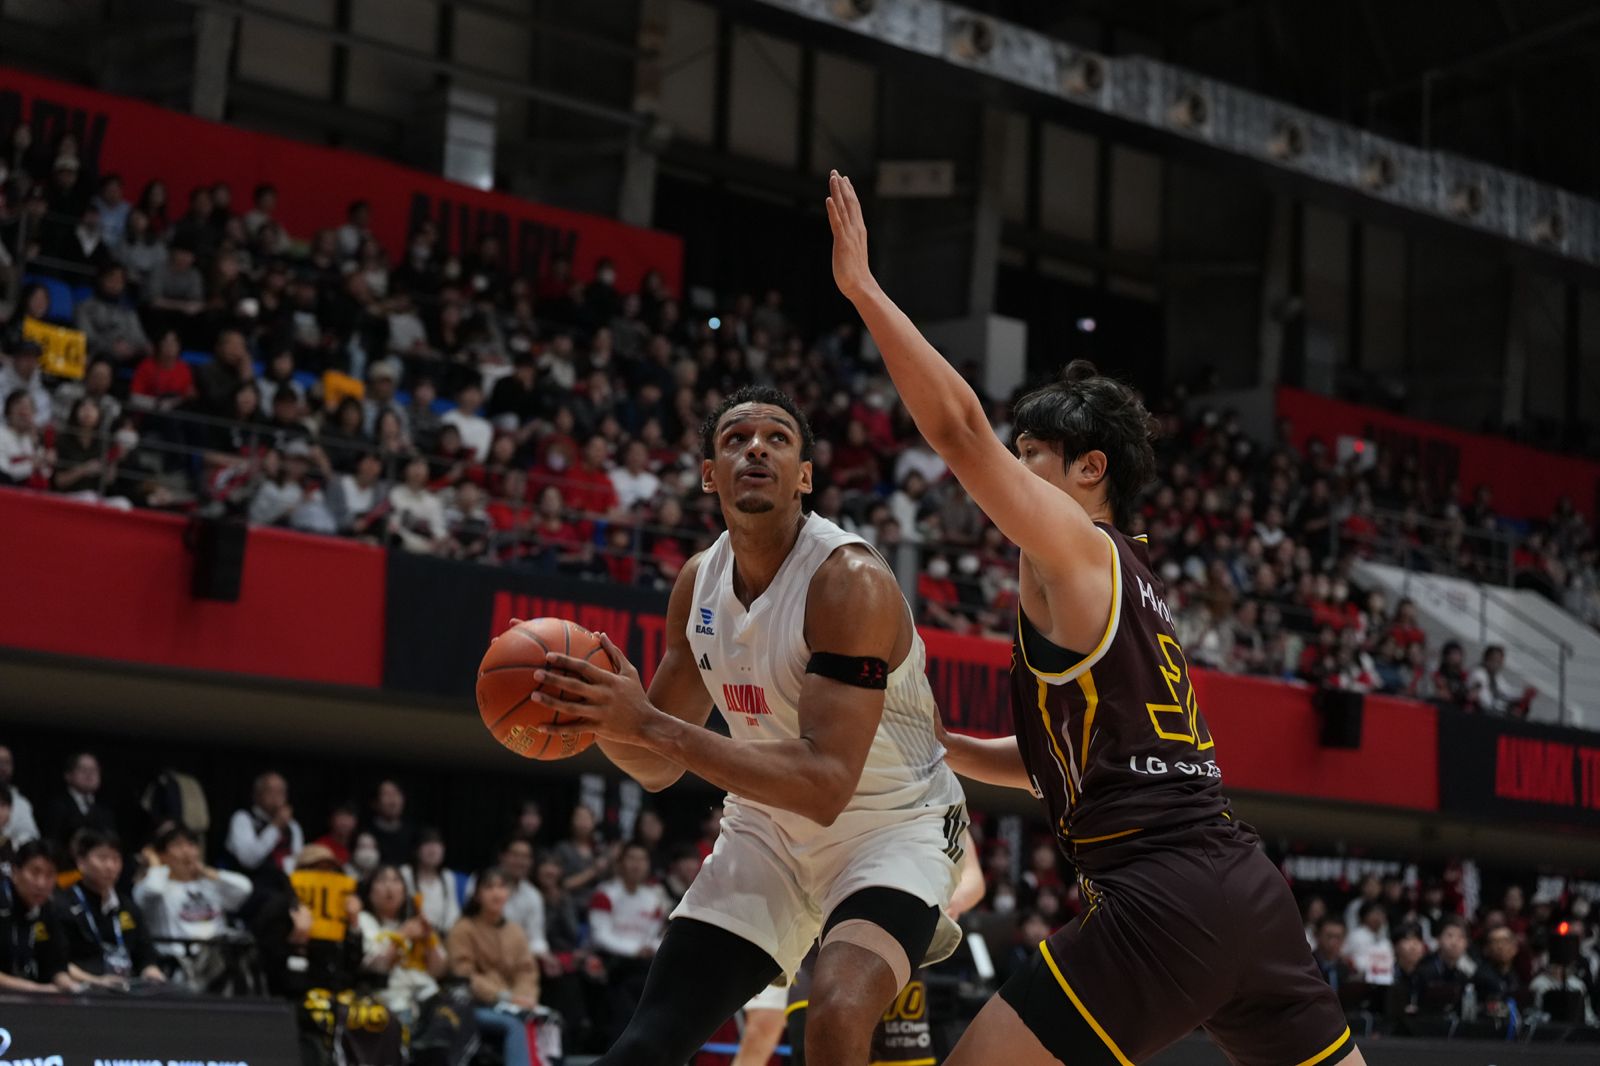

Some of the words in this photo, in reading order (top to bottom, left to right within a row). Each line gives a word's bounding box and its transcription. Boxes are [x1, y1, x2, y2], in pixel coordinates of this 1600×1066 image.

[695, 624, 715, 636] EASL
[722, 683, 773, 714] ALVARK
[1129, 755, 1168, 775] LG
